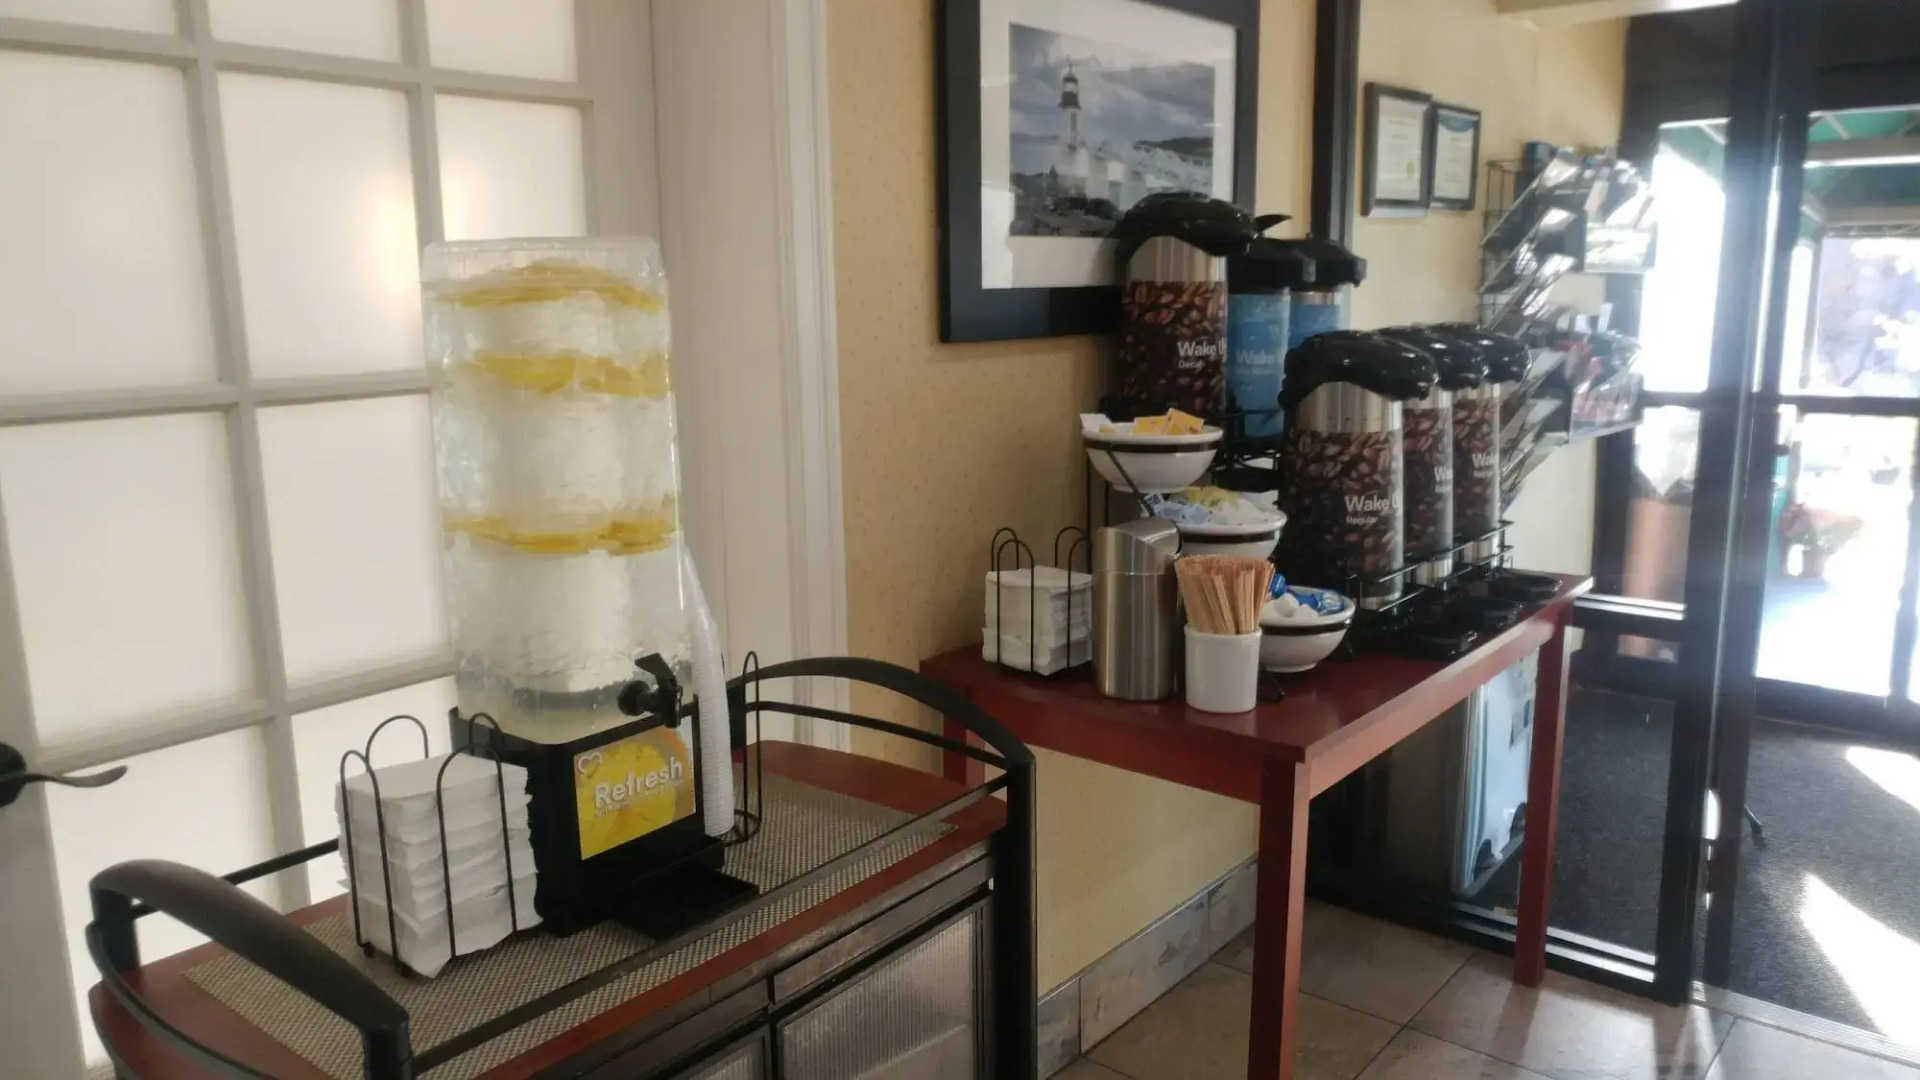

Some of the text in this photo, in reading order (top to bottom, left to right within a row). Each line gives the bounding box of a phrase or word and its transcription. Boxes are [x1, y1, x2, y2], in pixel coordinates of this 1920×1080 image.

[1177, 340, 1217, 356] Wake
[1344, 494, 1390, 511] Wake
[1346, 515, 1378, 526] Regular
[595, 756, 682, 809] Refresh
